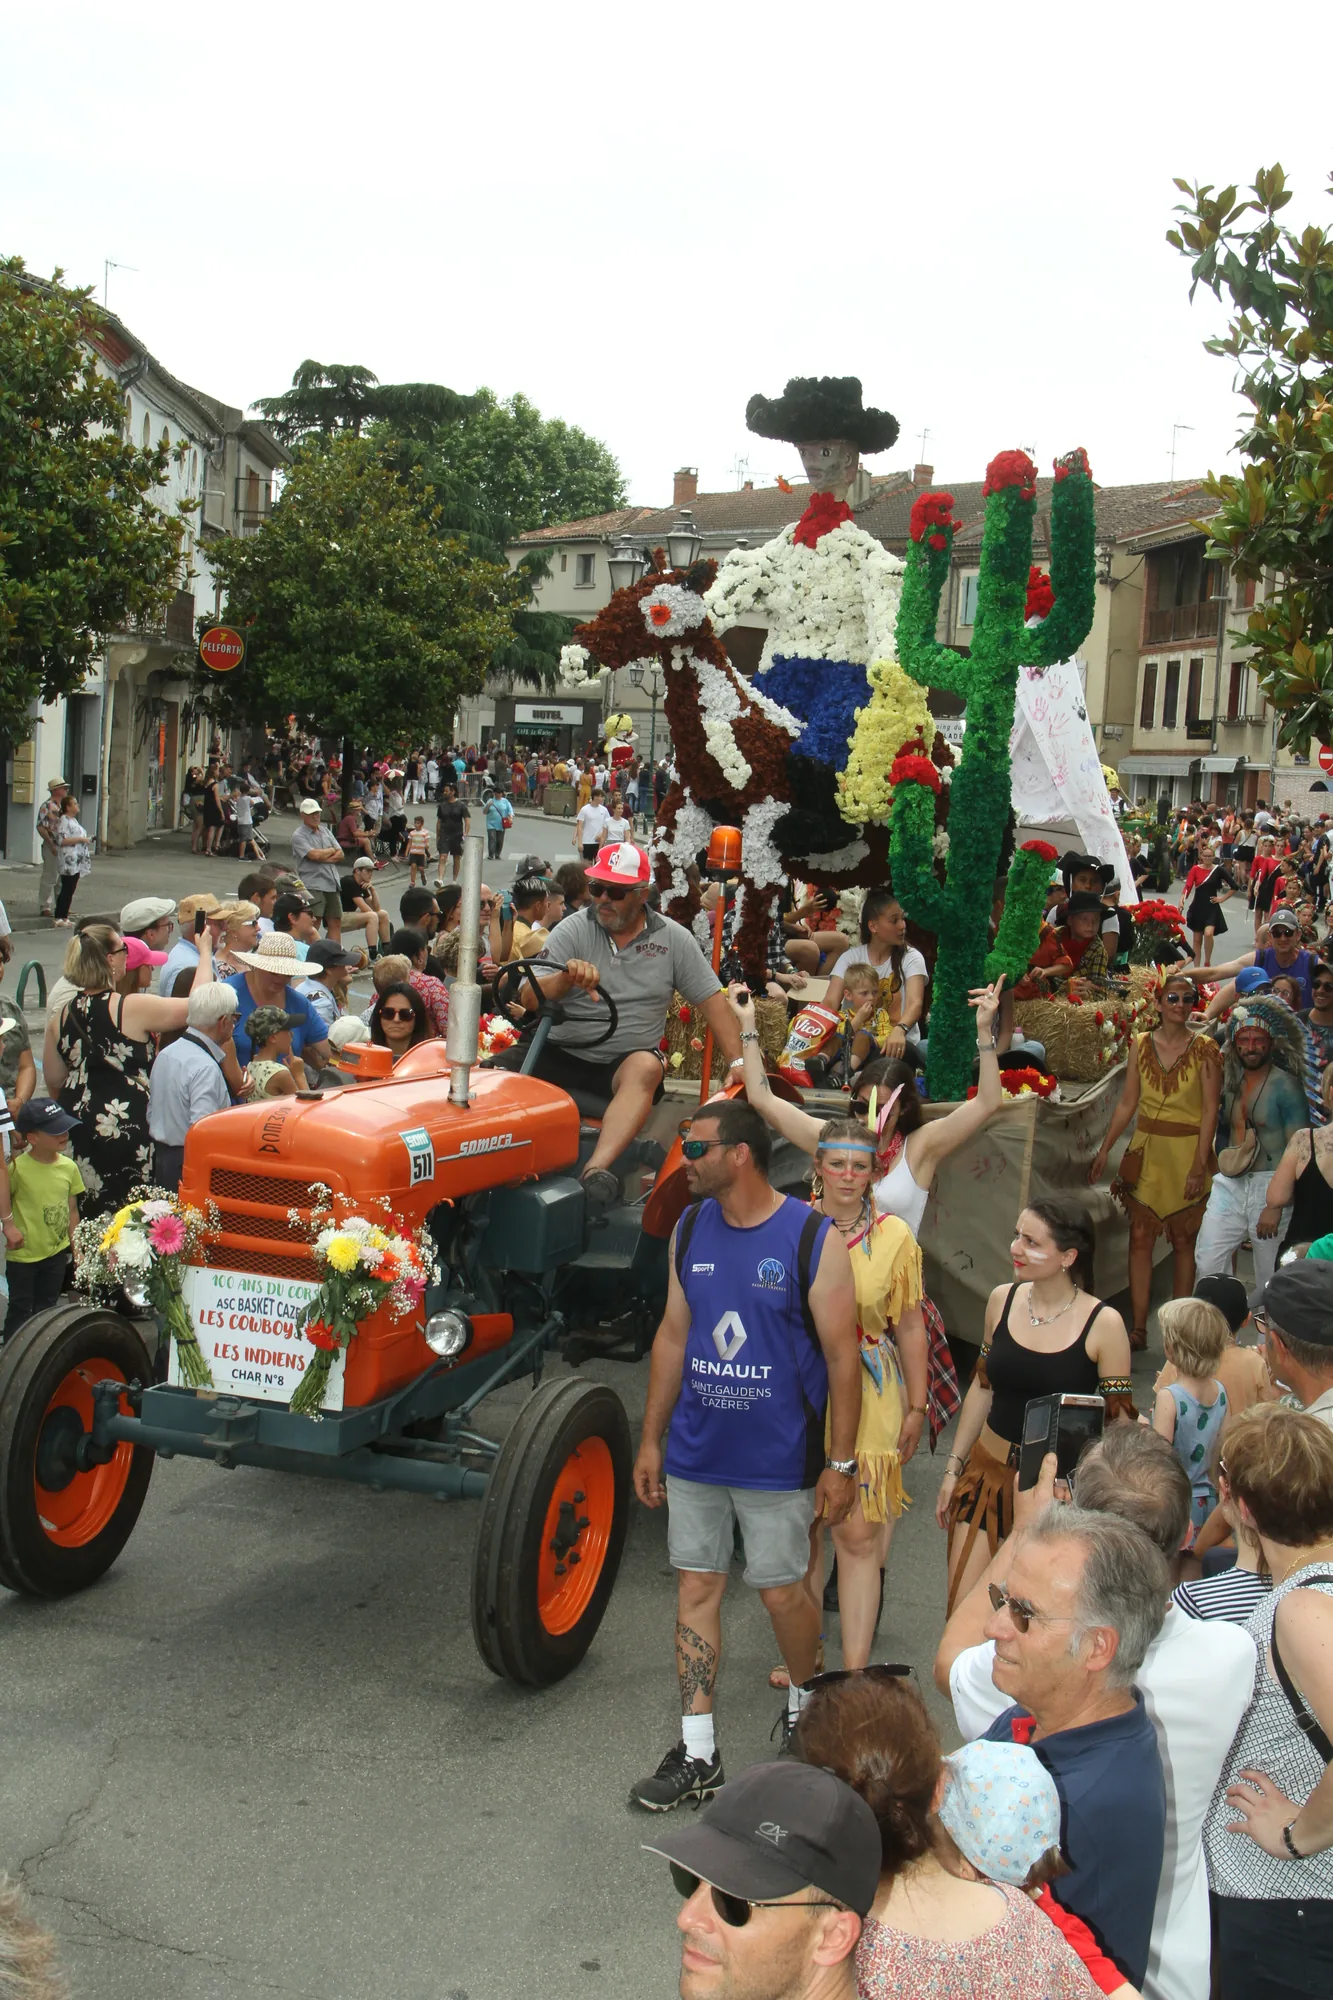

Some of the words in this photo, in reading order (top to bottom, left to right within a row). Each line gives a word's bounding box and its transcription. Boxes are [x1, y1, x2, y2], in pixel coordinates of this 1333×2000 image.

[202, 641, 242, 655] PELFORTH
[795, 1019, 821, 1035] Vico
[412, 1152, 432, 1180] 511
[212, 1274, 234, 1289] 100
[237, 1278, 263, 1294] ANS
[267, 1281, 284, 1297] DU
[287, 1285, 320, 1301] CORS
[199, 1309, 224, 1329] LES
[216, 1297, 236, 1311] ASC
[237, 1297, 276, 1316] BASKET
[276, 1301, 304, 1320] CAZE
[213, 1342, 240, 1362] LES
[244, 1346, 306, 1372] INDIENS
[231, 1368, 262, 1382] CHAR
[264, 1373, 285, 1386] N°8
[691, 1357, 772, 1380] RENAULT
[701, 1396, 750, 1410] CAZÈRES
